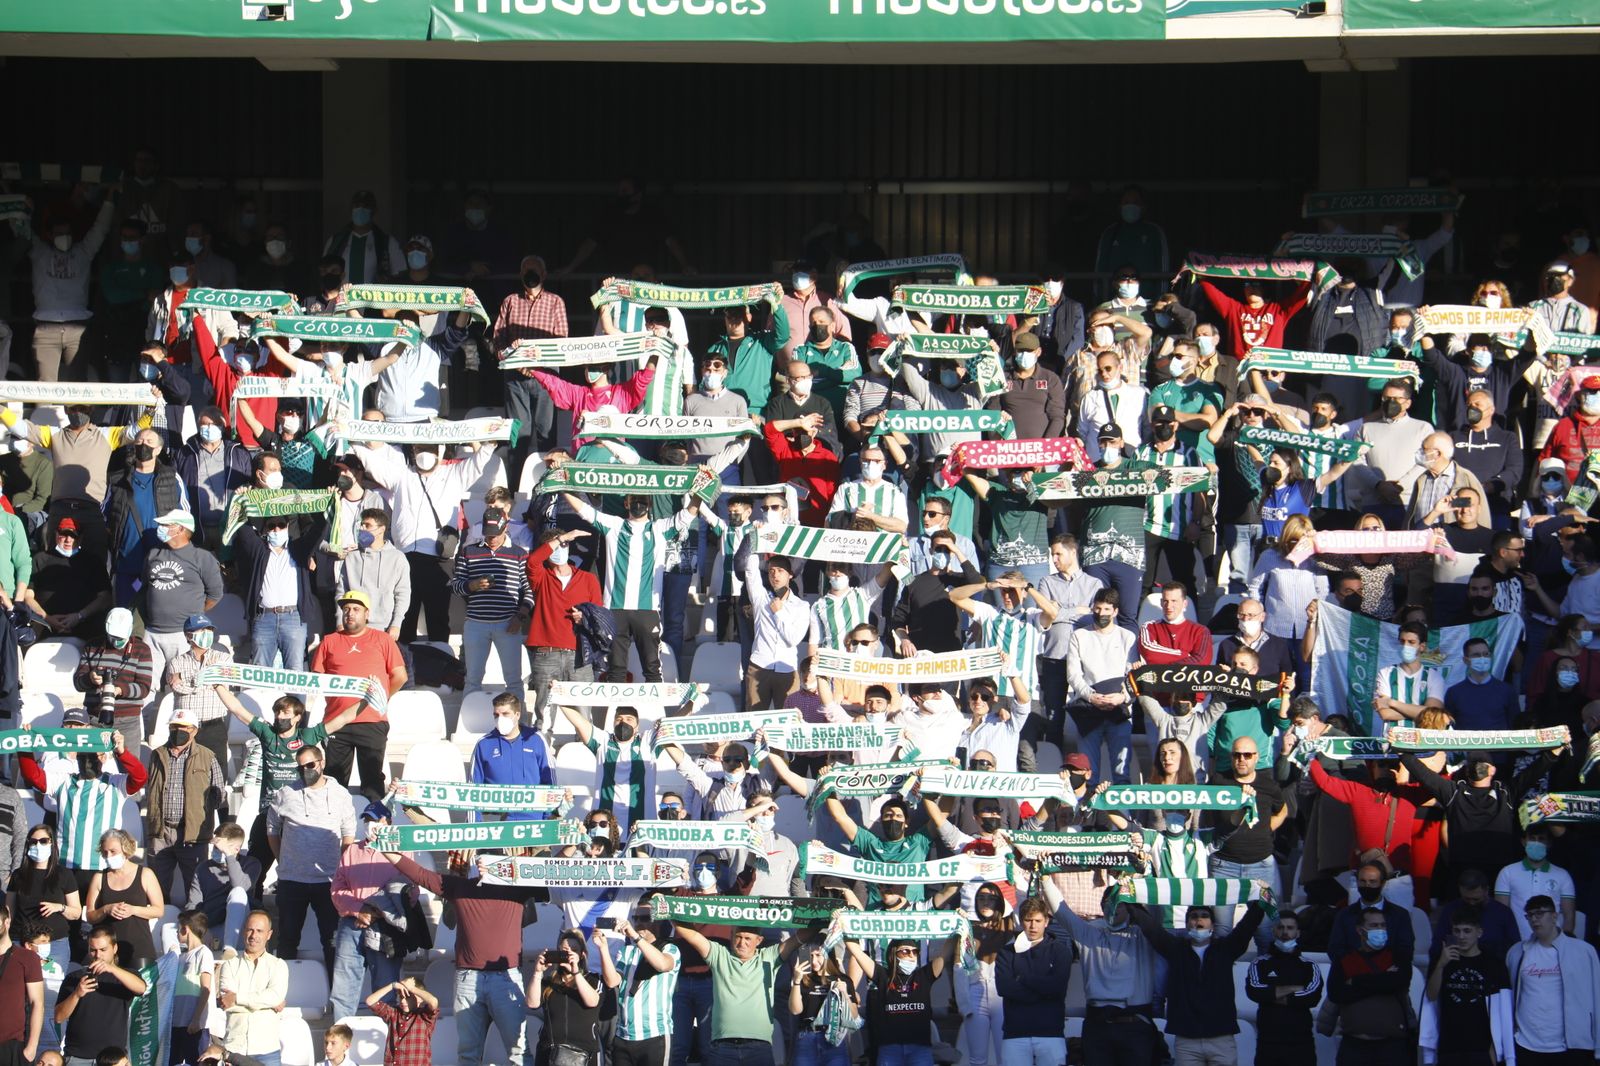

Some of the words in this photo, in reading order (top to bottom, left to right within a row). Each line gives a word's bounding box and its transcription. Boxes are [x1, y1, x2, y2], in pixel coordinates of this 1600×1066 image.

[193, 288, 273, 307] CÓRDOBA
[911, 289, 993, 308] CÓRDOBA
[996, 294, 1020, 307] CF
[1467, 311, 1483, 325] DE
[294, 318, 375, 337] CÓRDOBA
[608, 340, 620, 349] CF
[624, 414, 713, 429] CÓRDOBA
[880, 413, 974, 431] CÓRDOBA
[996, 442, 1043, 454] MUJER
[979, 452, 1061, 466] CORDOBESA
[574, 468, 659, 488] CÓRDOBA
[664, 474, 688, 487] CF
[853, 660, 893, 676] SOMOS
[896, 661, 912, 676] DE
[915, 658, 967, 675] PRIMERA
[328, 677, 358, 691] C.F.
[1161, 665, 1252, 691] CÓRDOBA
[570, 681, 660, 698] CÓRDOBA
[674, 720, 754, 737] CÓRDOBA
[791, 727, 806, 739] EL
[786, 736, 844, 750] NUESTRO
[835, 771, 903, 788] CÓRDO
[943, 773, 1040, 793] VOLVEREMOS
[1105, 788, 1212, 805] CÓRDOBA
[636, 824, 715, 842] CÓRDOBA
[1014, 832, 1035, 843] PEÑA
[1037, 835, 1095, 844] CORDOBESISTA
[1096, 833, 1128, 843] CAÑERO
[613, 864, 649, 881] C.F.
[939, 860, 961, 876] CF
[672, 901, 702, 917] C.F.
[705, 904, 793, 925] CÓRDOBA
